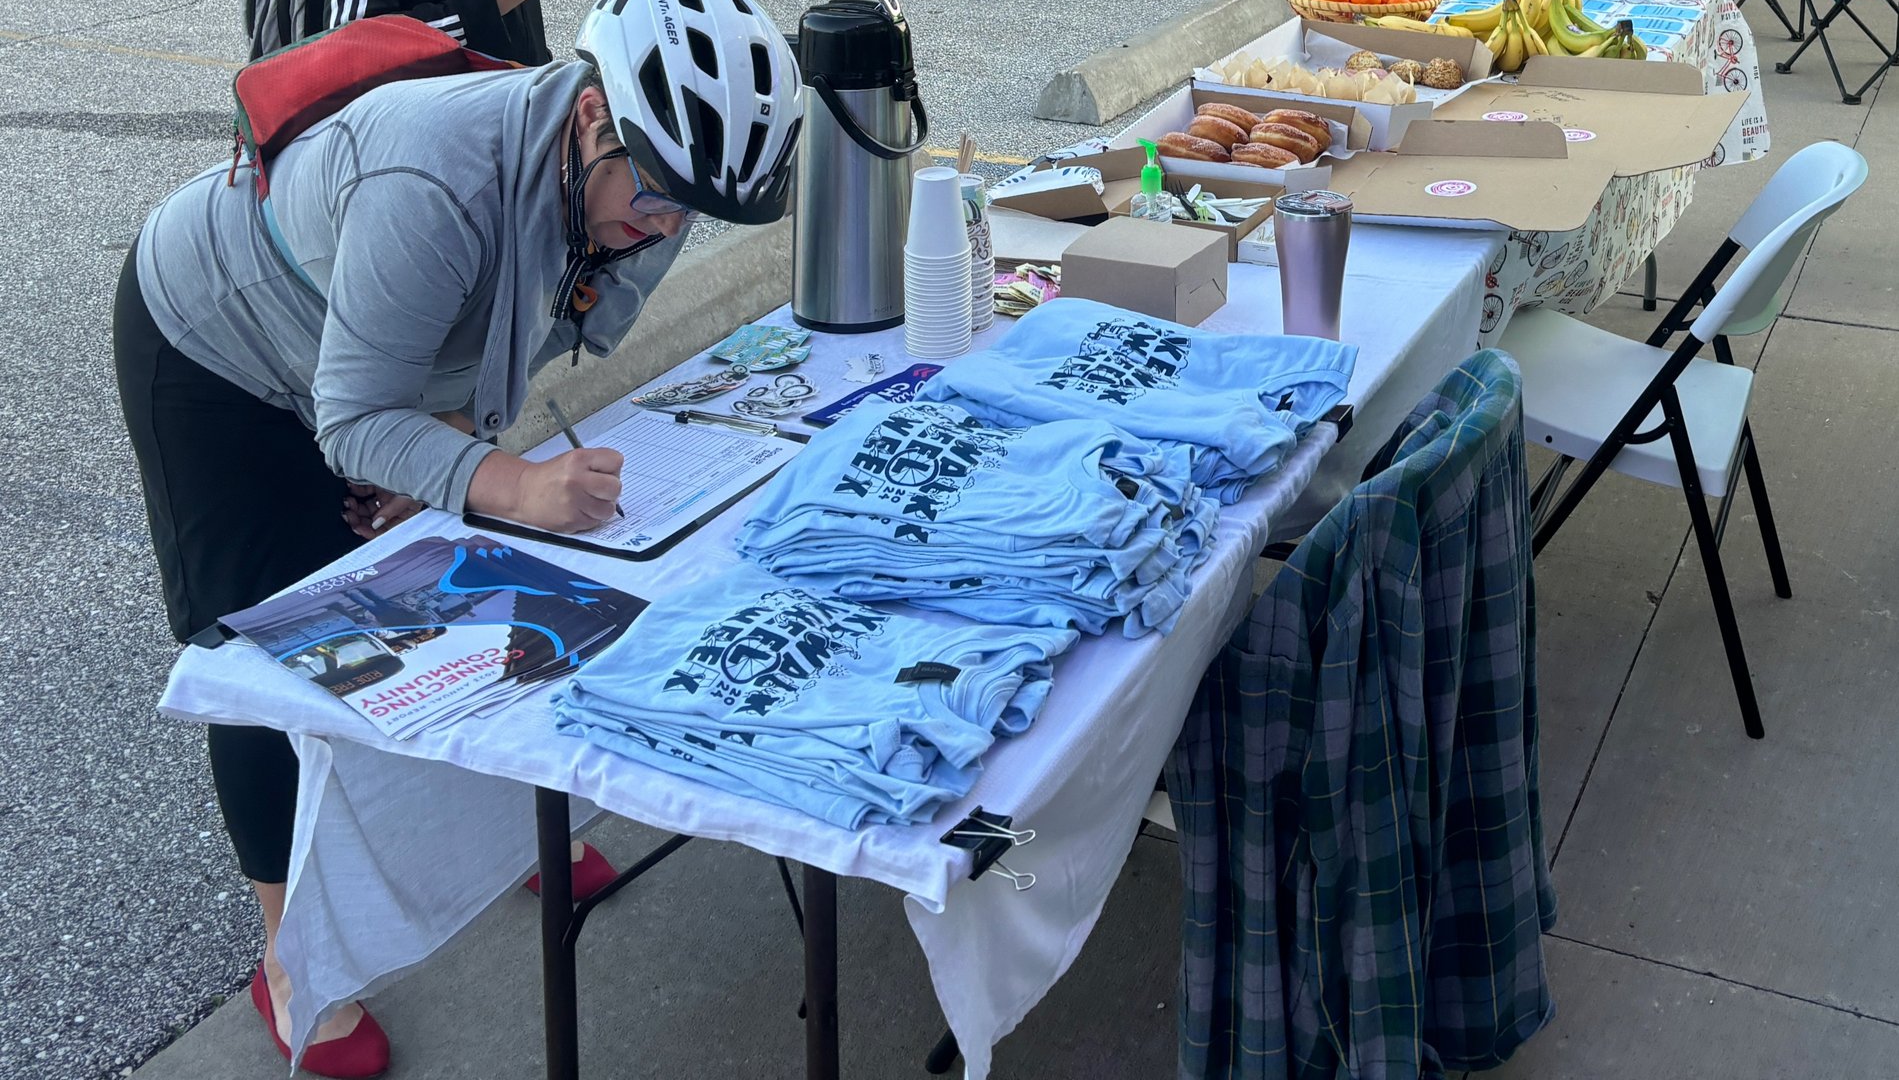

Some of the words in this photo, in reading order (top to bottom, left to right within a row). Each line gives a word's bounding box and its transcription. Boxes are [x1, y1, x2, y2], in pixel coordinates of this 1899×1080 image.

[1741, 117, 1753, 127] LIFE
[1742, 123, 1768, 137] BEAUTI
[834, 415, 925, 498] WEEK
[902, 439, 983, 522] WALK
[878, 486, 895, 500] 24
[890, 488, 906, 504] 20
[306, 575, 353, 597] LOCAL
[662, 606, 775, 695] WEEK
[353, 669, 383, 685] RIDE
[360, 647, 501, 709] COMMUNITY
[369, 649, 526, 718] CONNECTING
[733, 632, 832, 717] WALK
[431, 682, 470, 704] ANNUAL
[710, 680, 730, 698] 24
[723, 687, 742, 706] 20
[386, 705, 427, 726] REPORT
